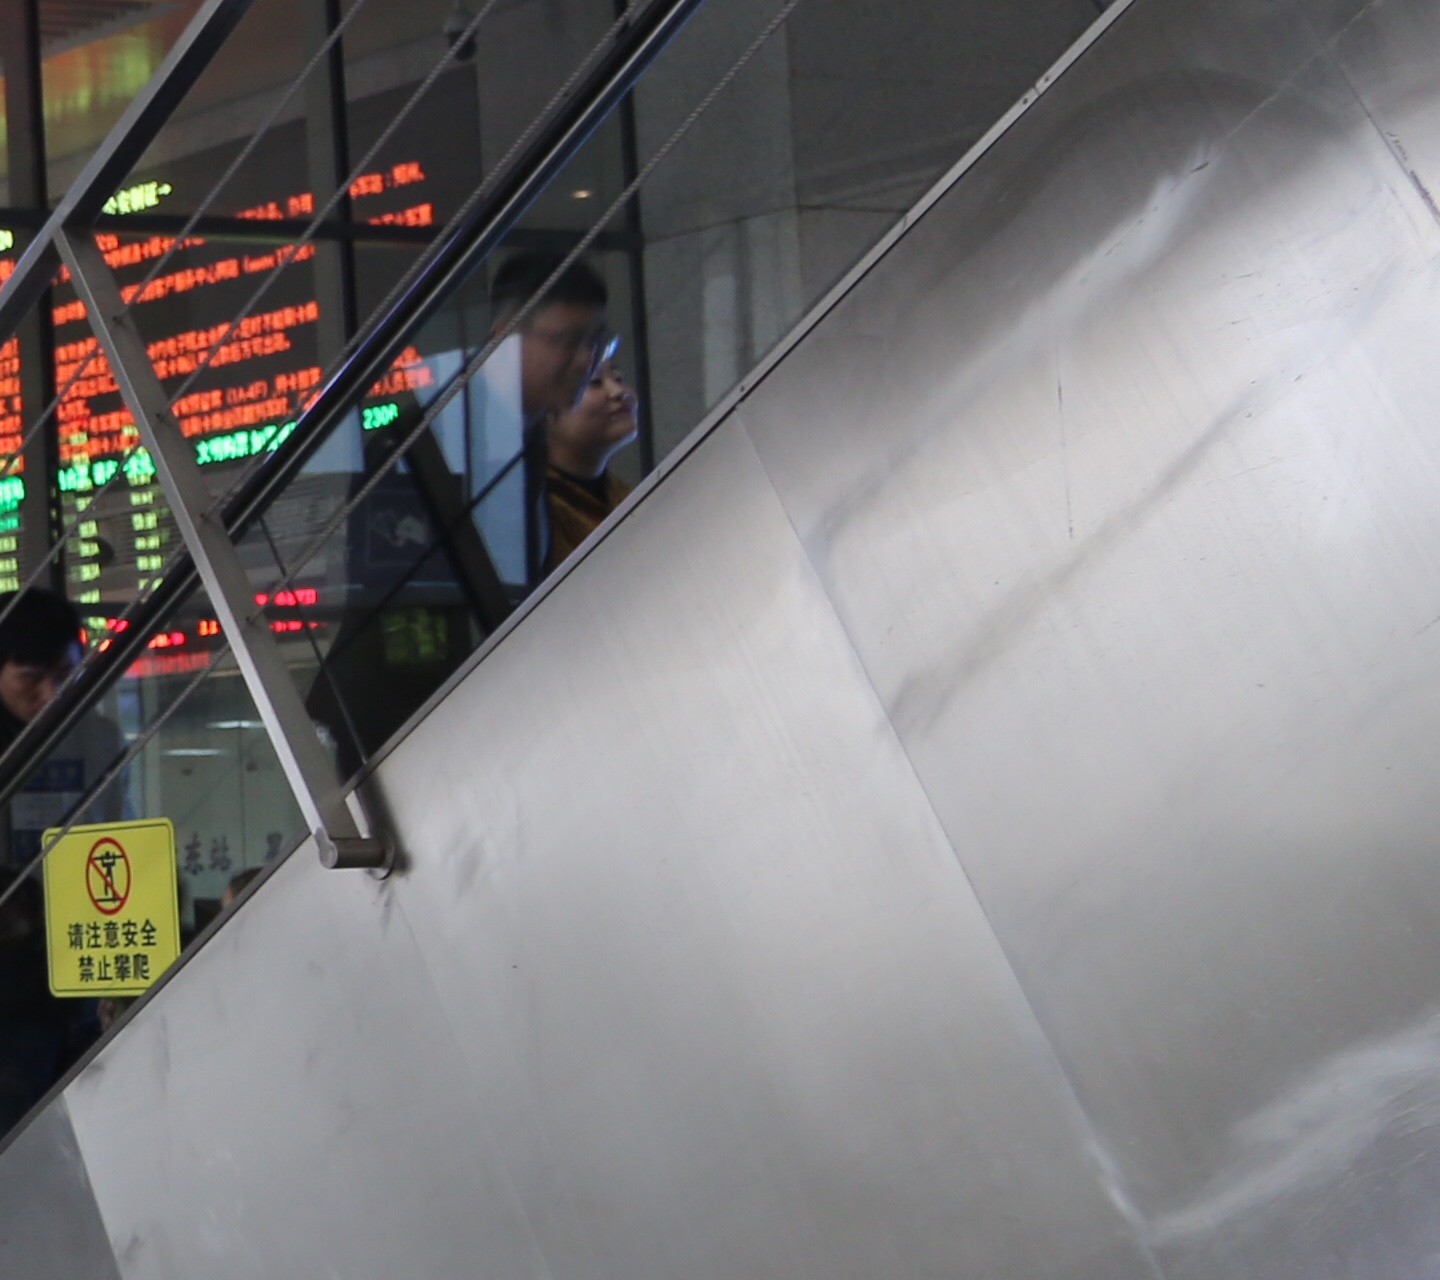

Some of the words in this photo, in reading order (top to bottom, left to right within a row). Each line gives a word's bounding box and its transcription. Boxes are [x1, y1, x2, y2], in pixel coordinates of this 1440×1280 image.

[67, 919, 157, 950] 请注意安全
[78, 953, 150, 982] 禁止攀爬
